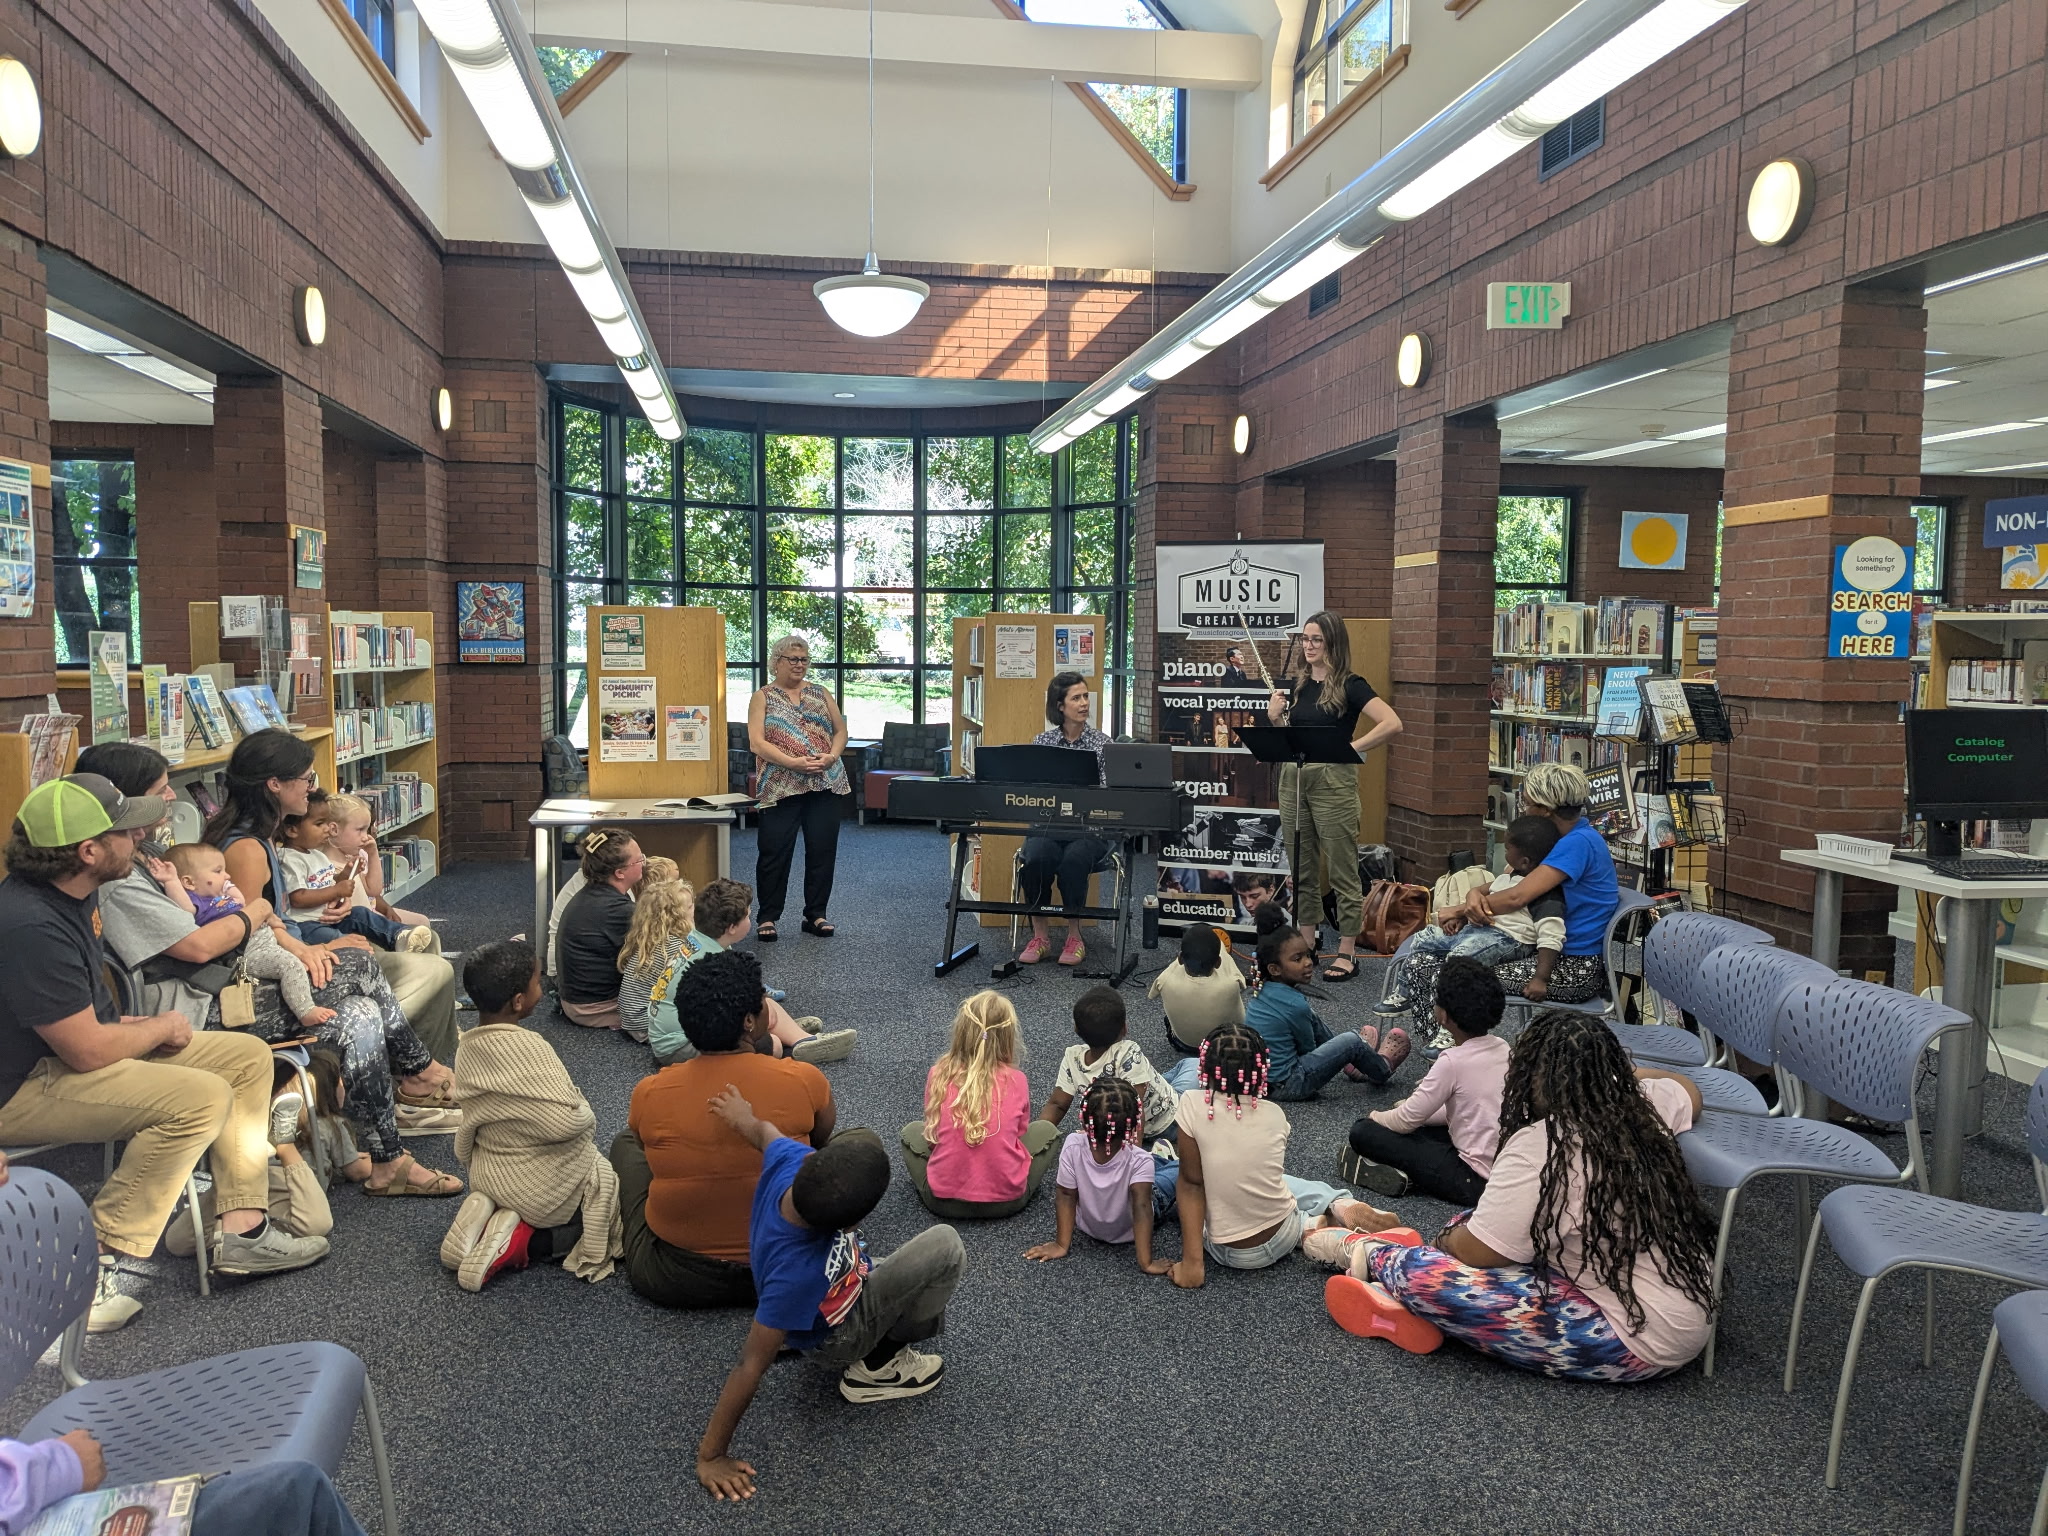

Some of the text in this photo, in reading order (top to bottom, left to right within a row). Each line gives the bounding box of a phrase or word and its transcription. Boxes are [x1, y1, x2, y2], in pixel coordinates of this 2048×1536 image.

[1505, 286, 1553, 323] EXIT
[1996, 512, 2048, 531] NON-
[1857, 556, 1882, 564] Looking
[1195, 579, 1281, 602] MUSIC
[1833, 593, 1910, 610] SEARCH
[1196, 615, 1280, 626] GREAT PACE
[1842, 637, 1893, 654] HERE
[1163, 658, 1226, 680] piano
[1613, 670, 1639, 679] NEVER
[1608, 680, 1637, 688] ENOUG
[1163, 696, 1203, 708] vocal
[1955, 738, 2005, 747] Catalog
[1948, 753, 2014, 763] Computer
[1172, 781, 1228, 798] rgan
[1588, 788, 1621, 804] WIRE
[1005, 793, 1056, 808] Roland
[1163, 845, 1280, 863] chamber music
[1163, 901, 1236, 918] education
